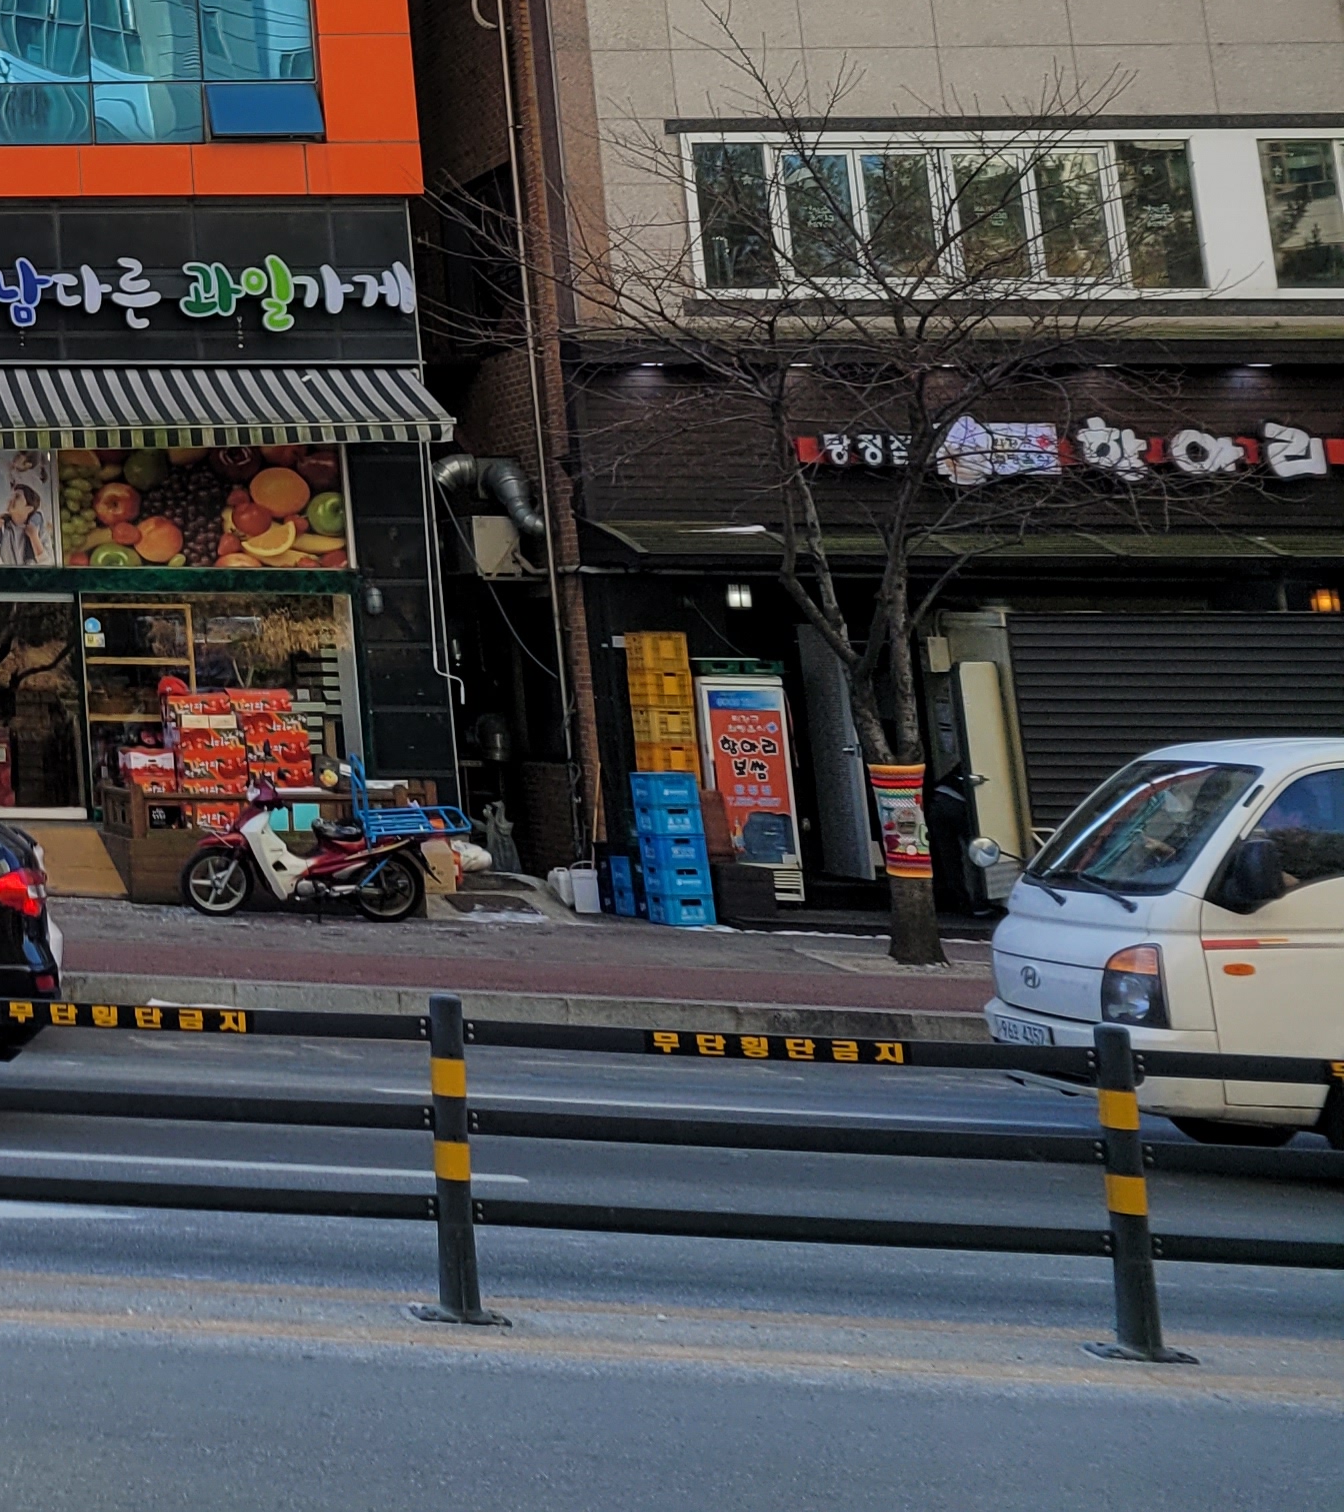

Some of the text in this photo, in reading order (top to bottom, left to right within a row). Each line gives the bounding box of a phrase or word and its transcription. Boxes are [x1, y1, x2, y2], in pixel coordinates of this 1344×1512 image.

[179, 253, 416, 333] 과일가게
[719, 735, 779, 756] 항아리
[8, 1000, 248, 1034] 무단횡단금지
[652, 1031, 905, 1065] 무단횡단금지
